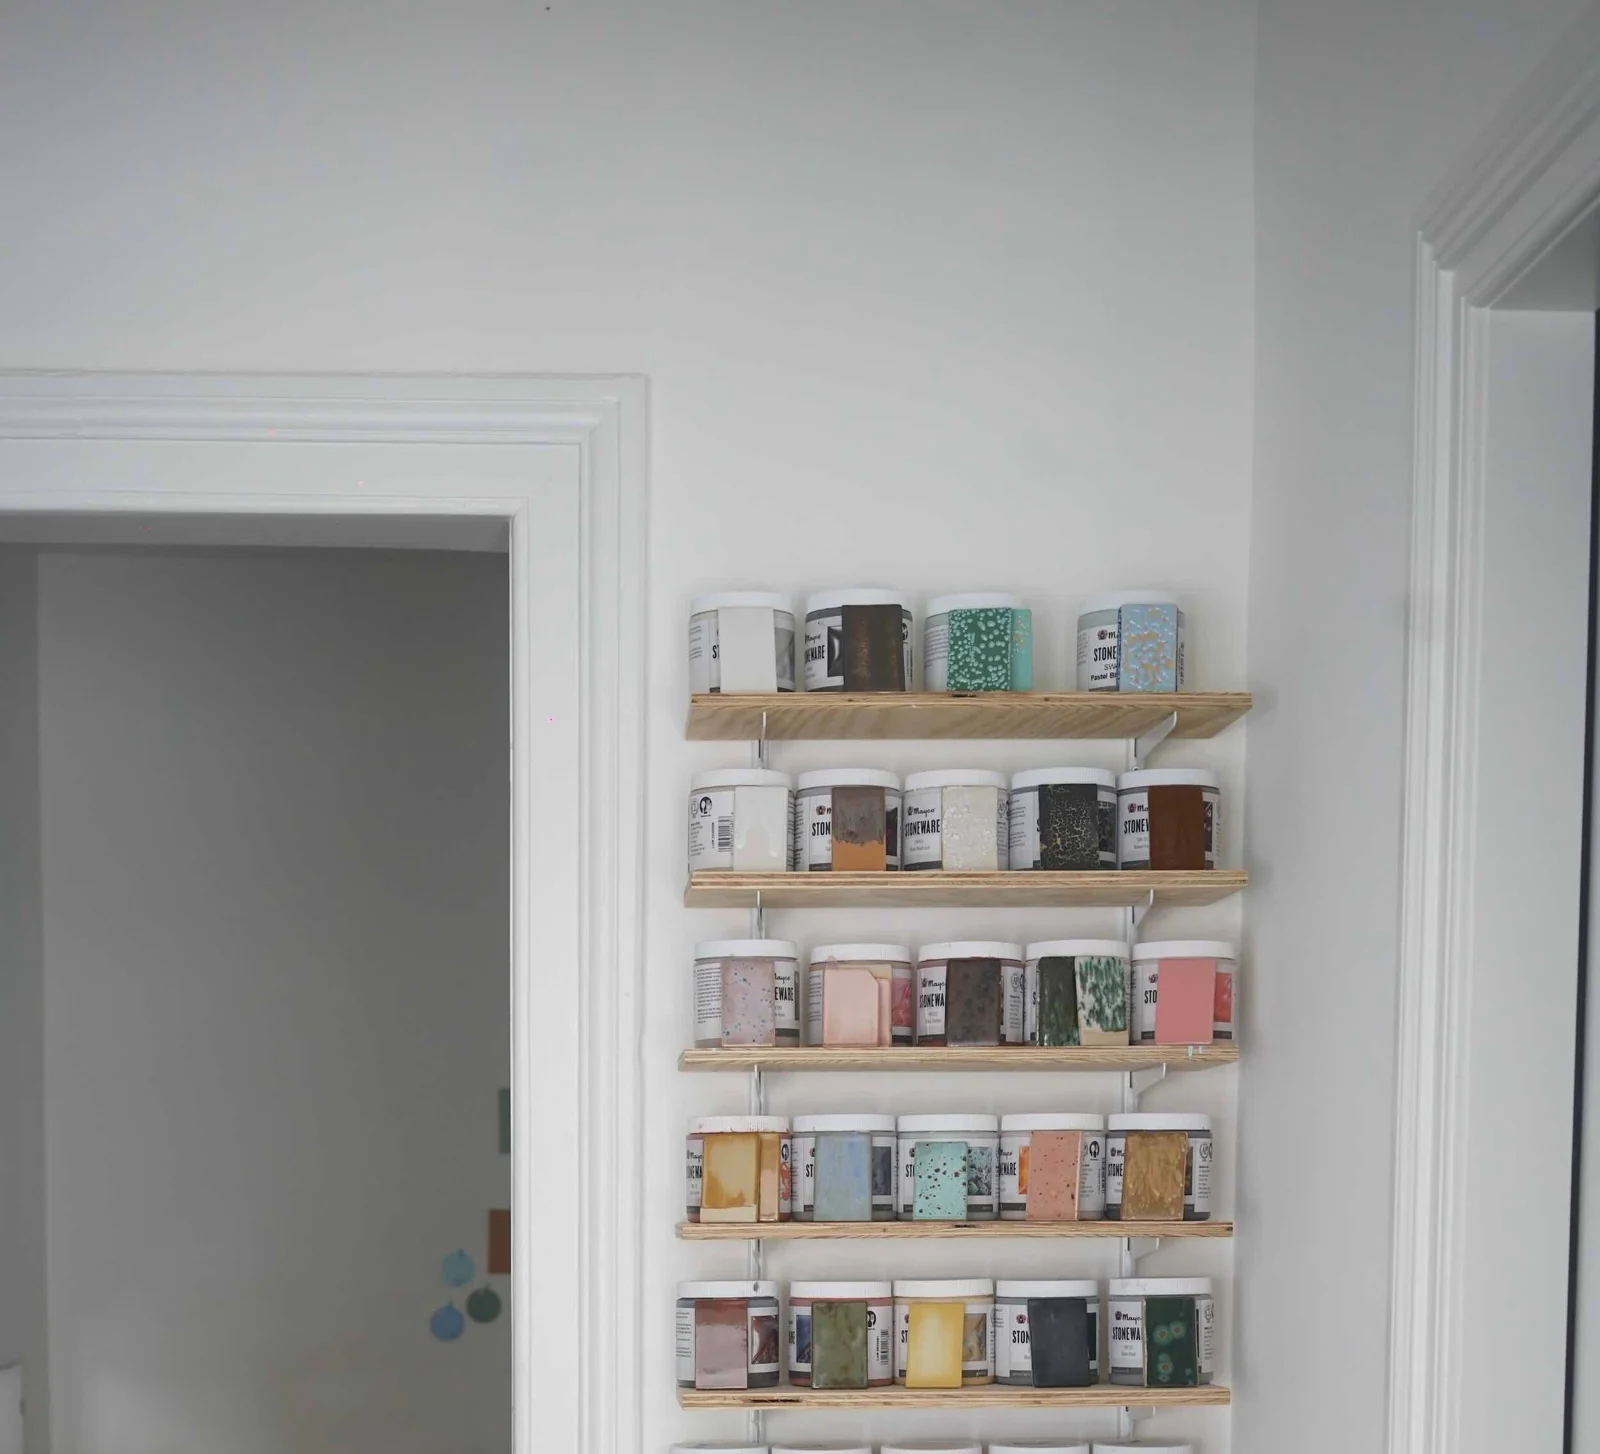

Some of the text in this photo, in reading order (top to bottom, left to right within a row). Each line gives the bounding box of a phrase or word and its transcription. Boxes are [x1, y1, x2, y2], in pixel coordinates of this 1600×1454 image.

[1090, 673, 1108, 682] Pastel
[913, 806, 936, 817] Mayco
[904, 818, 941, 837] STONEWARE
